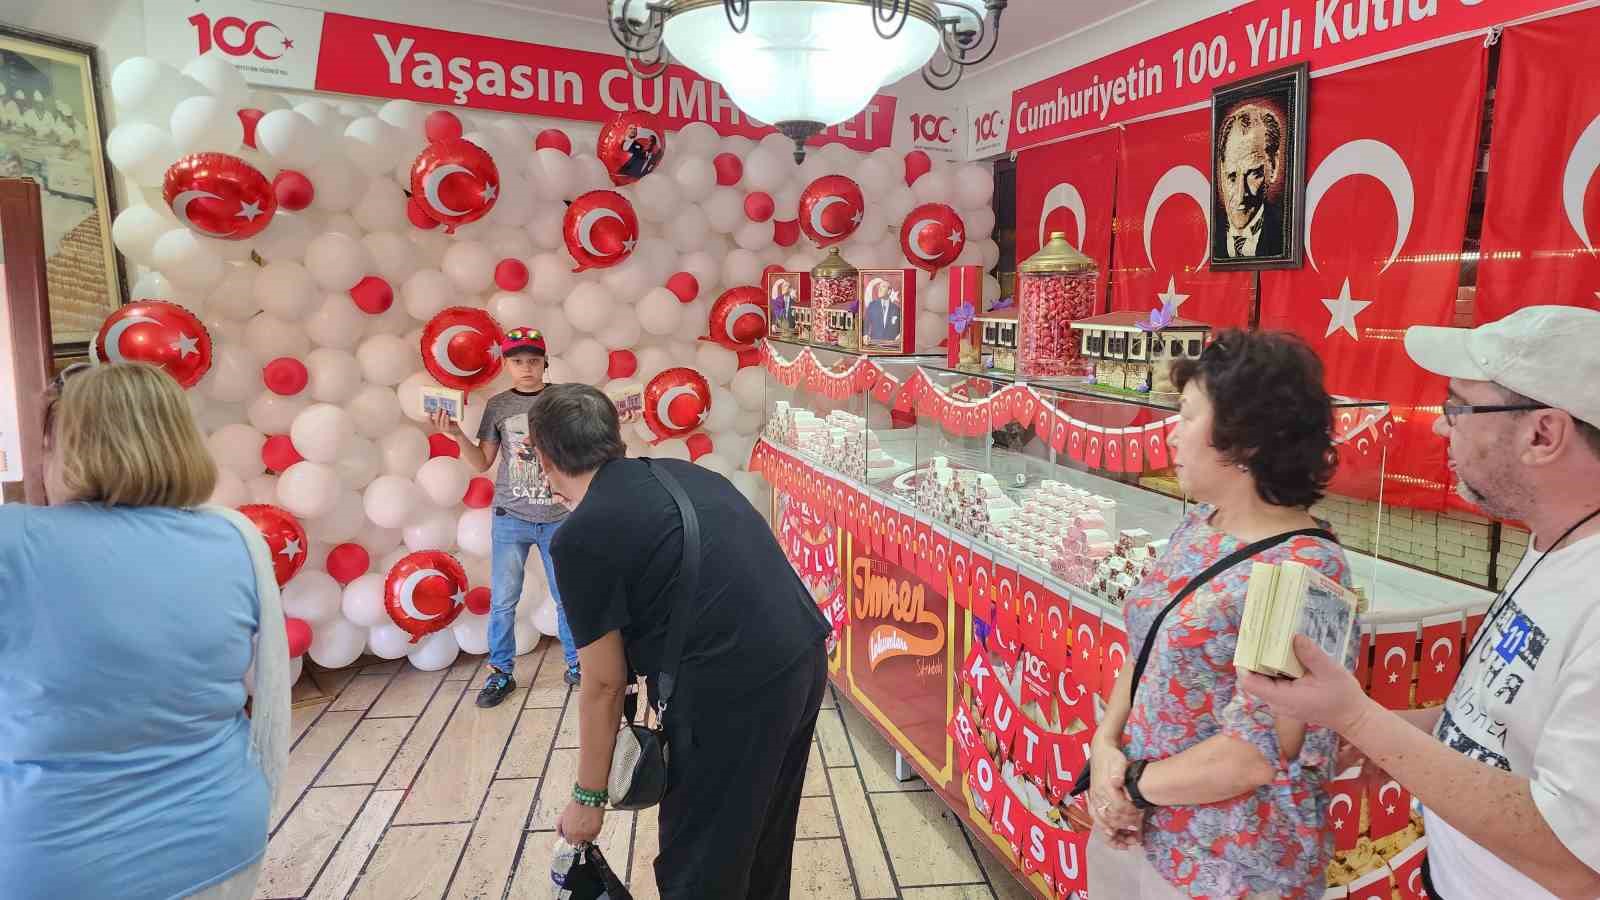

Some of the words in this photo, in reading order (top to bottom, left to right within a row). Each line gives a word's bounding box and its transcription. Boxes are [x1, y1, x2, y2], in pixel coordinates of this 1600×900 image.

[372, 33, 584, 105] Yaşasın
[599, 68, 880, 140] CUMHET
[1016, 58, 1163, 135] Cumhuriyetin
[1172, 41, 1236, 89] 100.
[1245, 7, 1303, 68] Yılı
[970, 653, 1092, 782] KUTL
